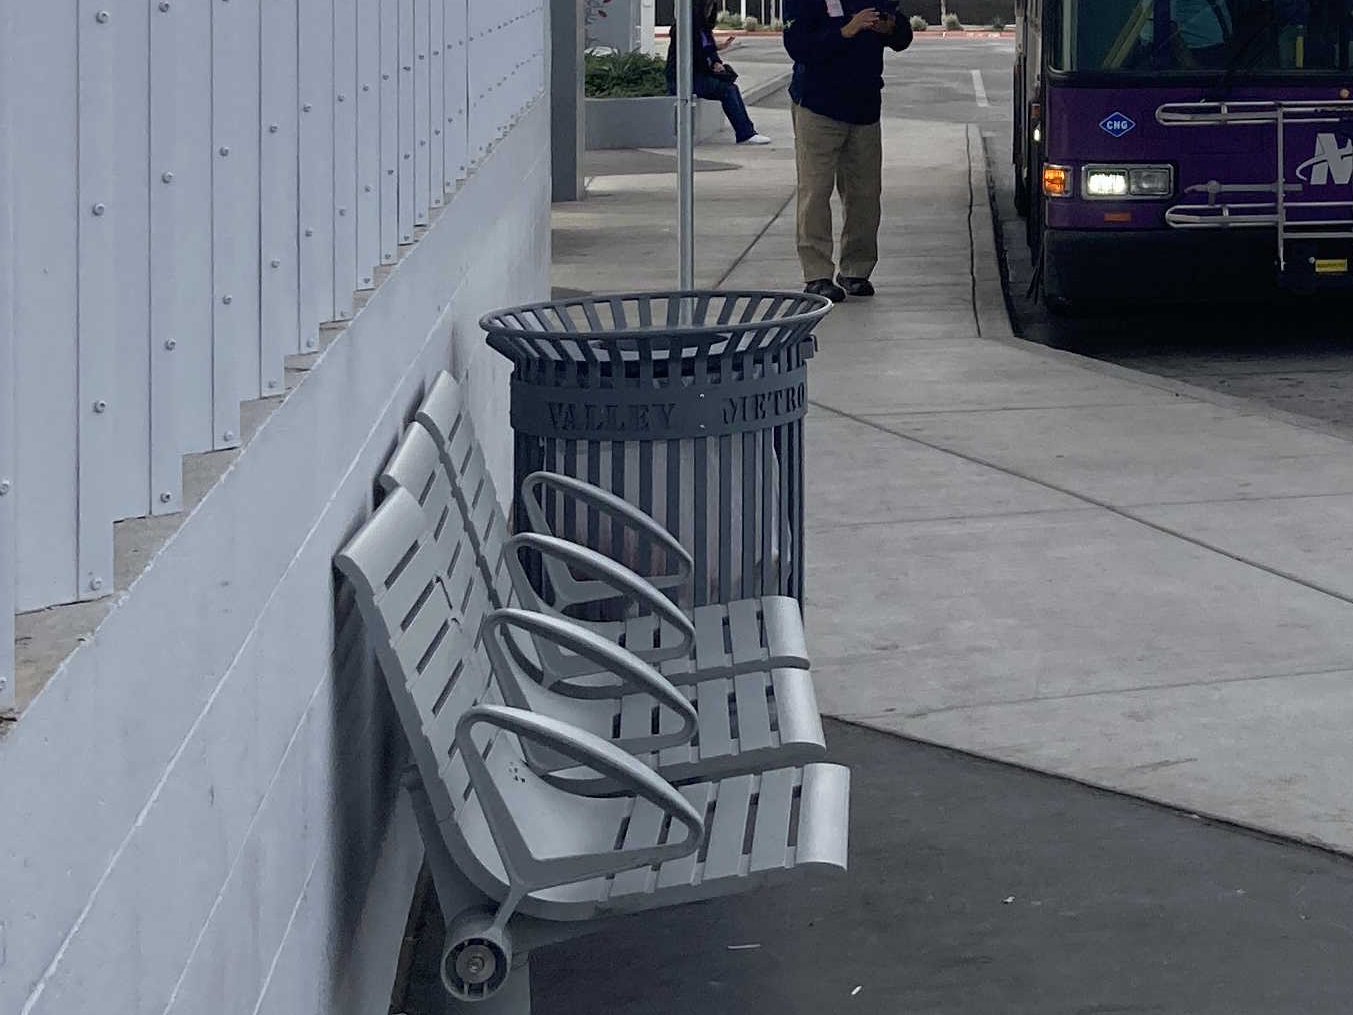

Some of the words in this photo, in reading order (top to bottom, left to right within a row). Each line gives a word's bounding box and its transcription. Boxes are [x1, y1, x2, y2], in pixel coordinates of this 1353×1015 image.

[1106, 120, 1128, 130] CNG
[549, 401, 676, 430] VALLEY
[723, 382, 805, 425] METRO
